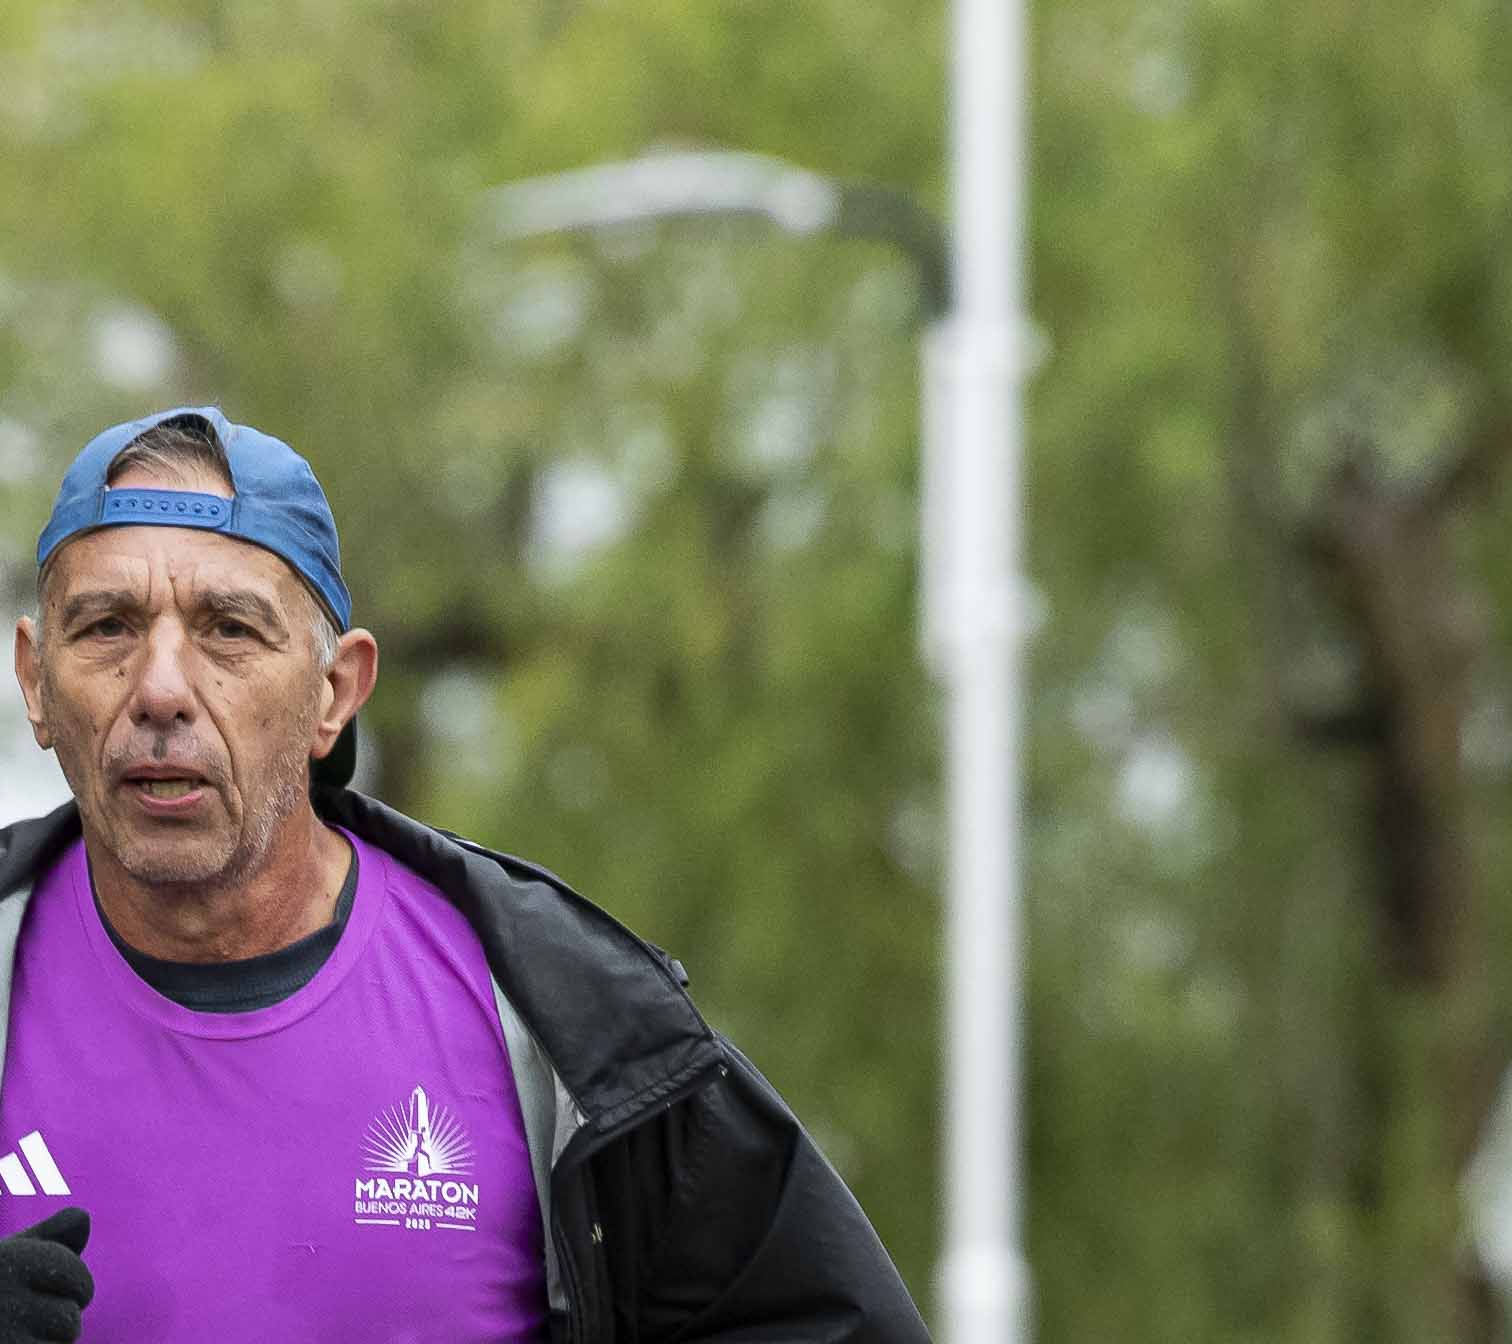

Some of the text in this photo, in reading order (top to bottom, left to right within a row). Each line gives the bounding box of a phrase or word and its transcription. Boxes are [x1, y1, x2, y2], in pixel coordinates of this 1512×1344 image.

[355, 1178, 479, 1205] MARATON
[355, 1200, 477, 1220] BUENOS AIRES 42K
